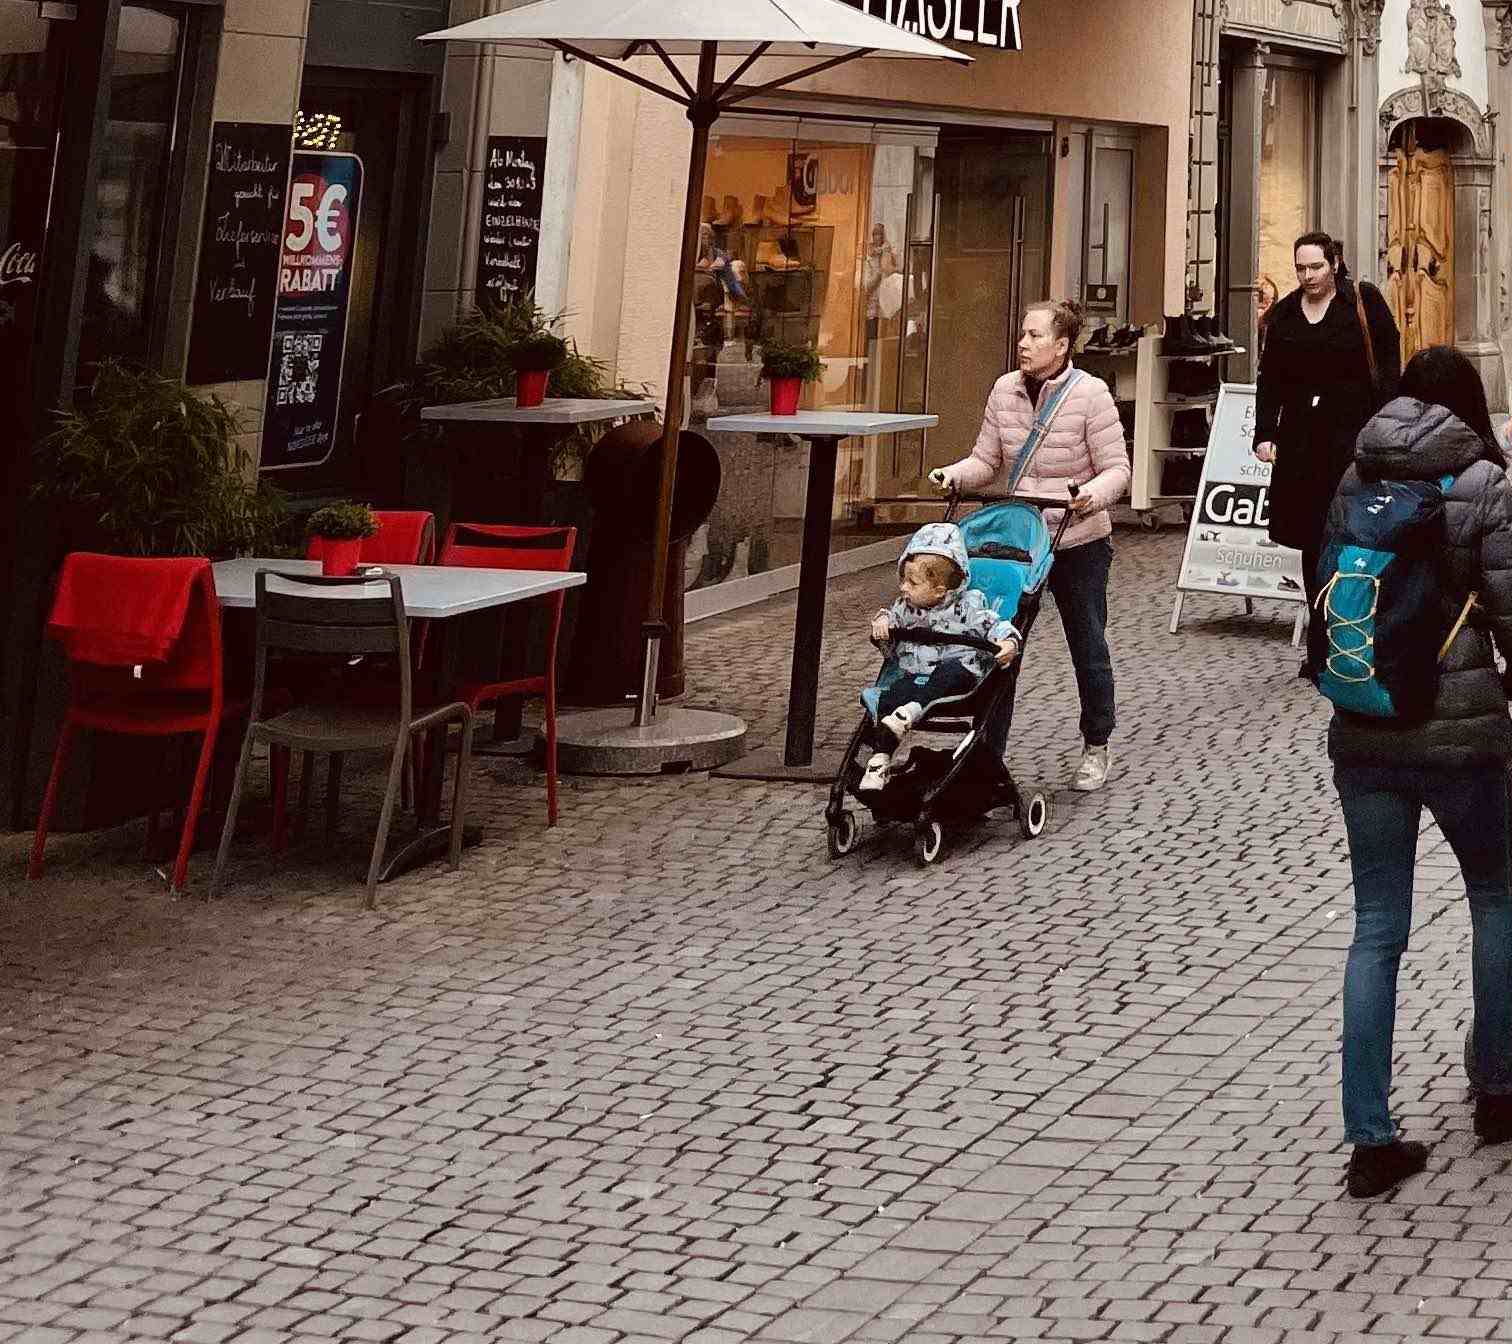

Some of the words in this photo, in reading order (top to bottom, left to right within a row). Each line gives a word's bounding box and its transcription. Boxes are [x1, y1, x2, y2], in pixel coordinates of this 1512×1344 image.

[285, 182, 348, 252] 5€
[280, 268, 340, 292] RABATT
[1205, 484, 1270, 526] Gab
